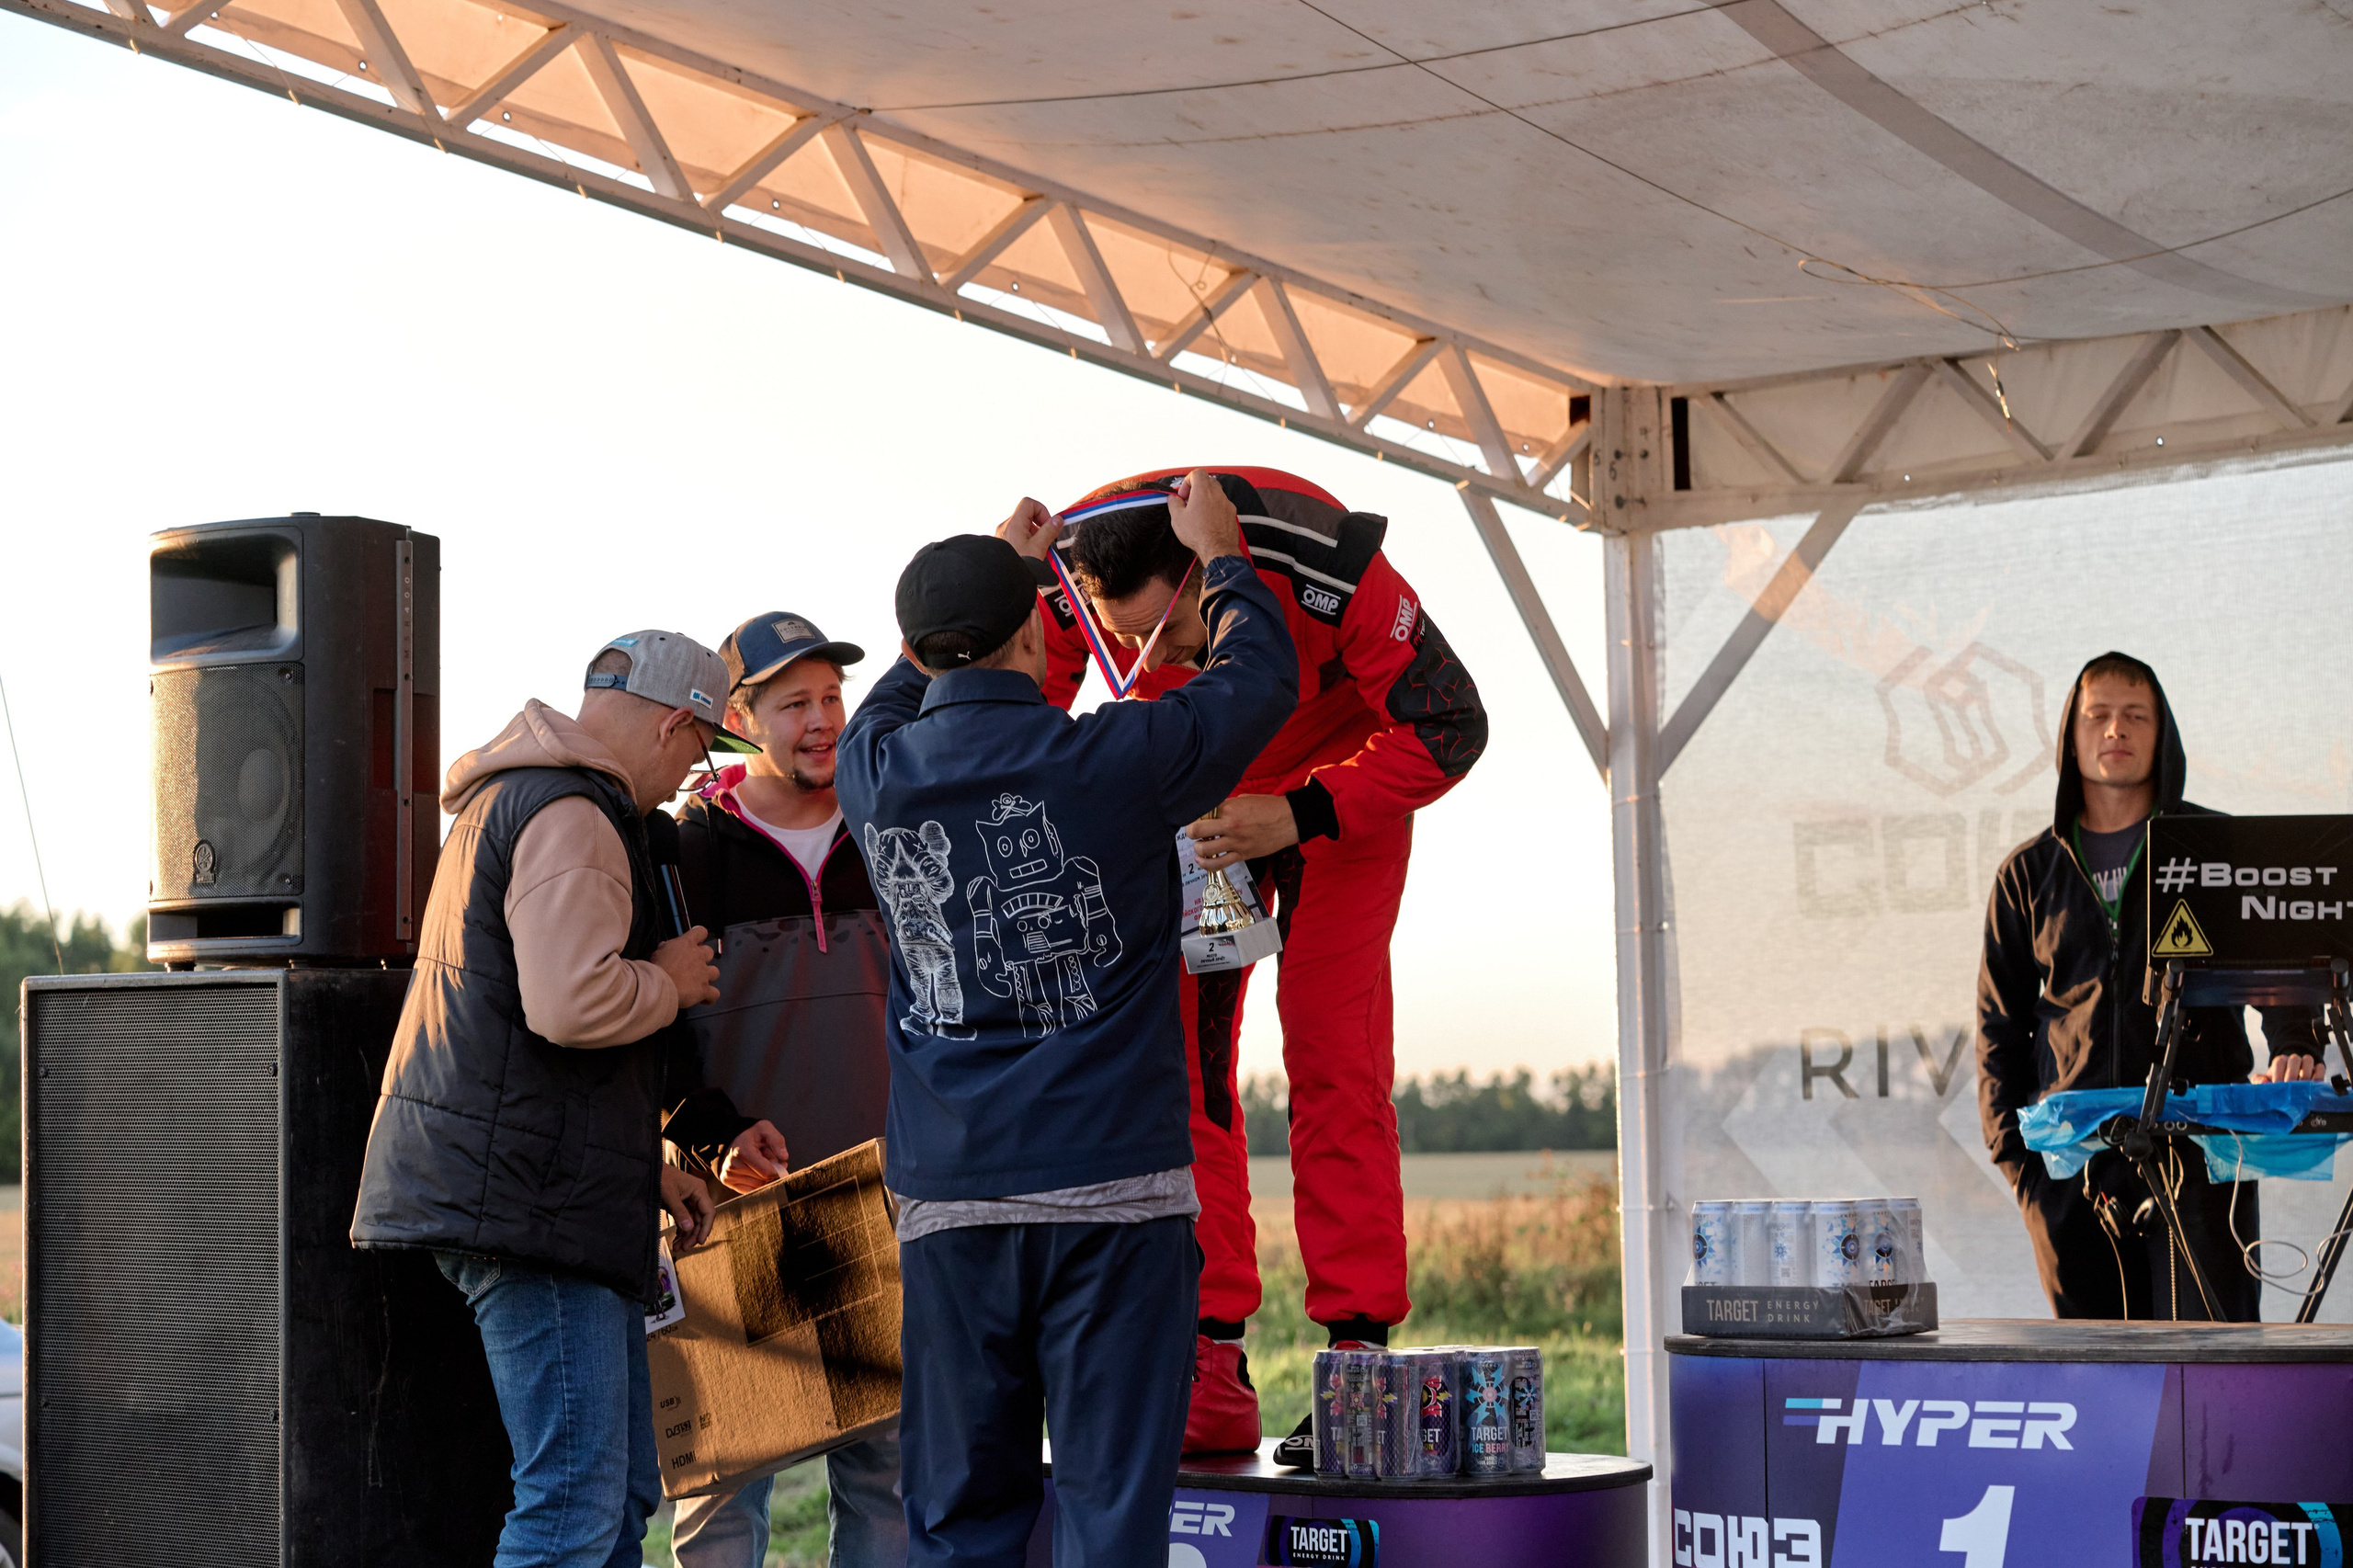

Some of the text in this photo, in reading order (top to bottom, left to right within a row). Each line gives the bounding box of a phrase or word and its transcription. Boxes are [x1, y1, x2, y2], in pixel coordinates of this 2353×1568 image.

[1302, 589, 1339, 613] OMP
[1394, 597, 1415, 642] OMP
[1209, 942, 1214, 952] 2
[1706, 1299, 1819, 1323] TARGET ENERGY
[1768, 1313, 1811, 1324] DRINK
[660, 1397, 675, 1409] USB
[1471, 1426, 1508, 1441] TARGET
[1814, 1397, 2078, 1451] HYPER
[672, 1450, 696, 1470] HDMI
[1472, 1443, 1484, 1454] ICE
[1674, 1507, 1822, 1568] СОЮЗ
[1938, 1484, 2016, 1568] 1
[1290, 1526, 1347, 1553] TARGET
[2185, 1517, 2313, 1565] TARGET
[1292, 1551, 1346, 1562] ENERGY DRINK
